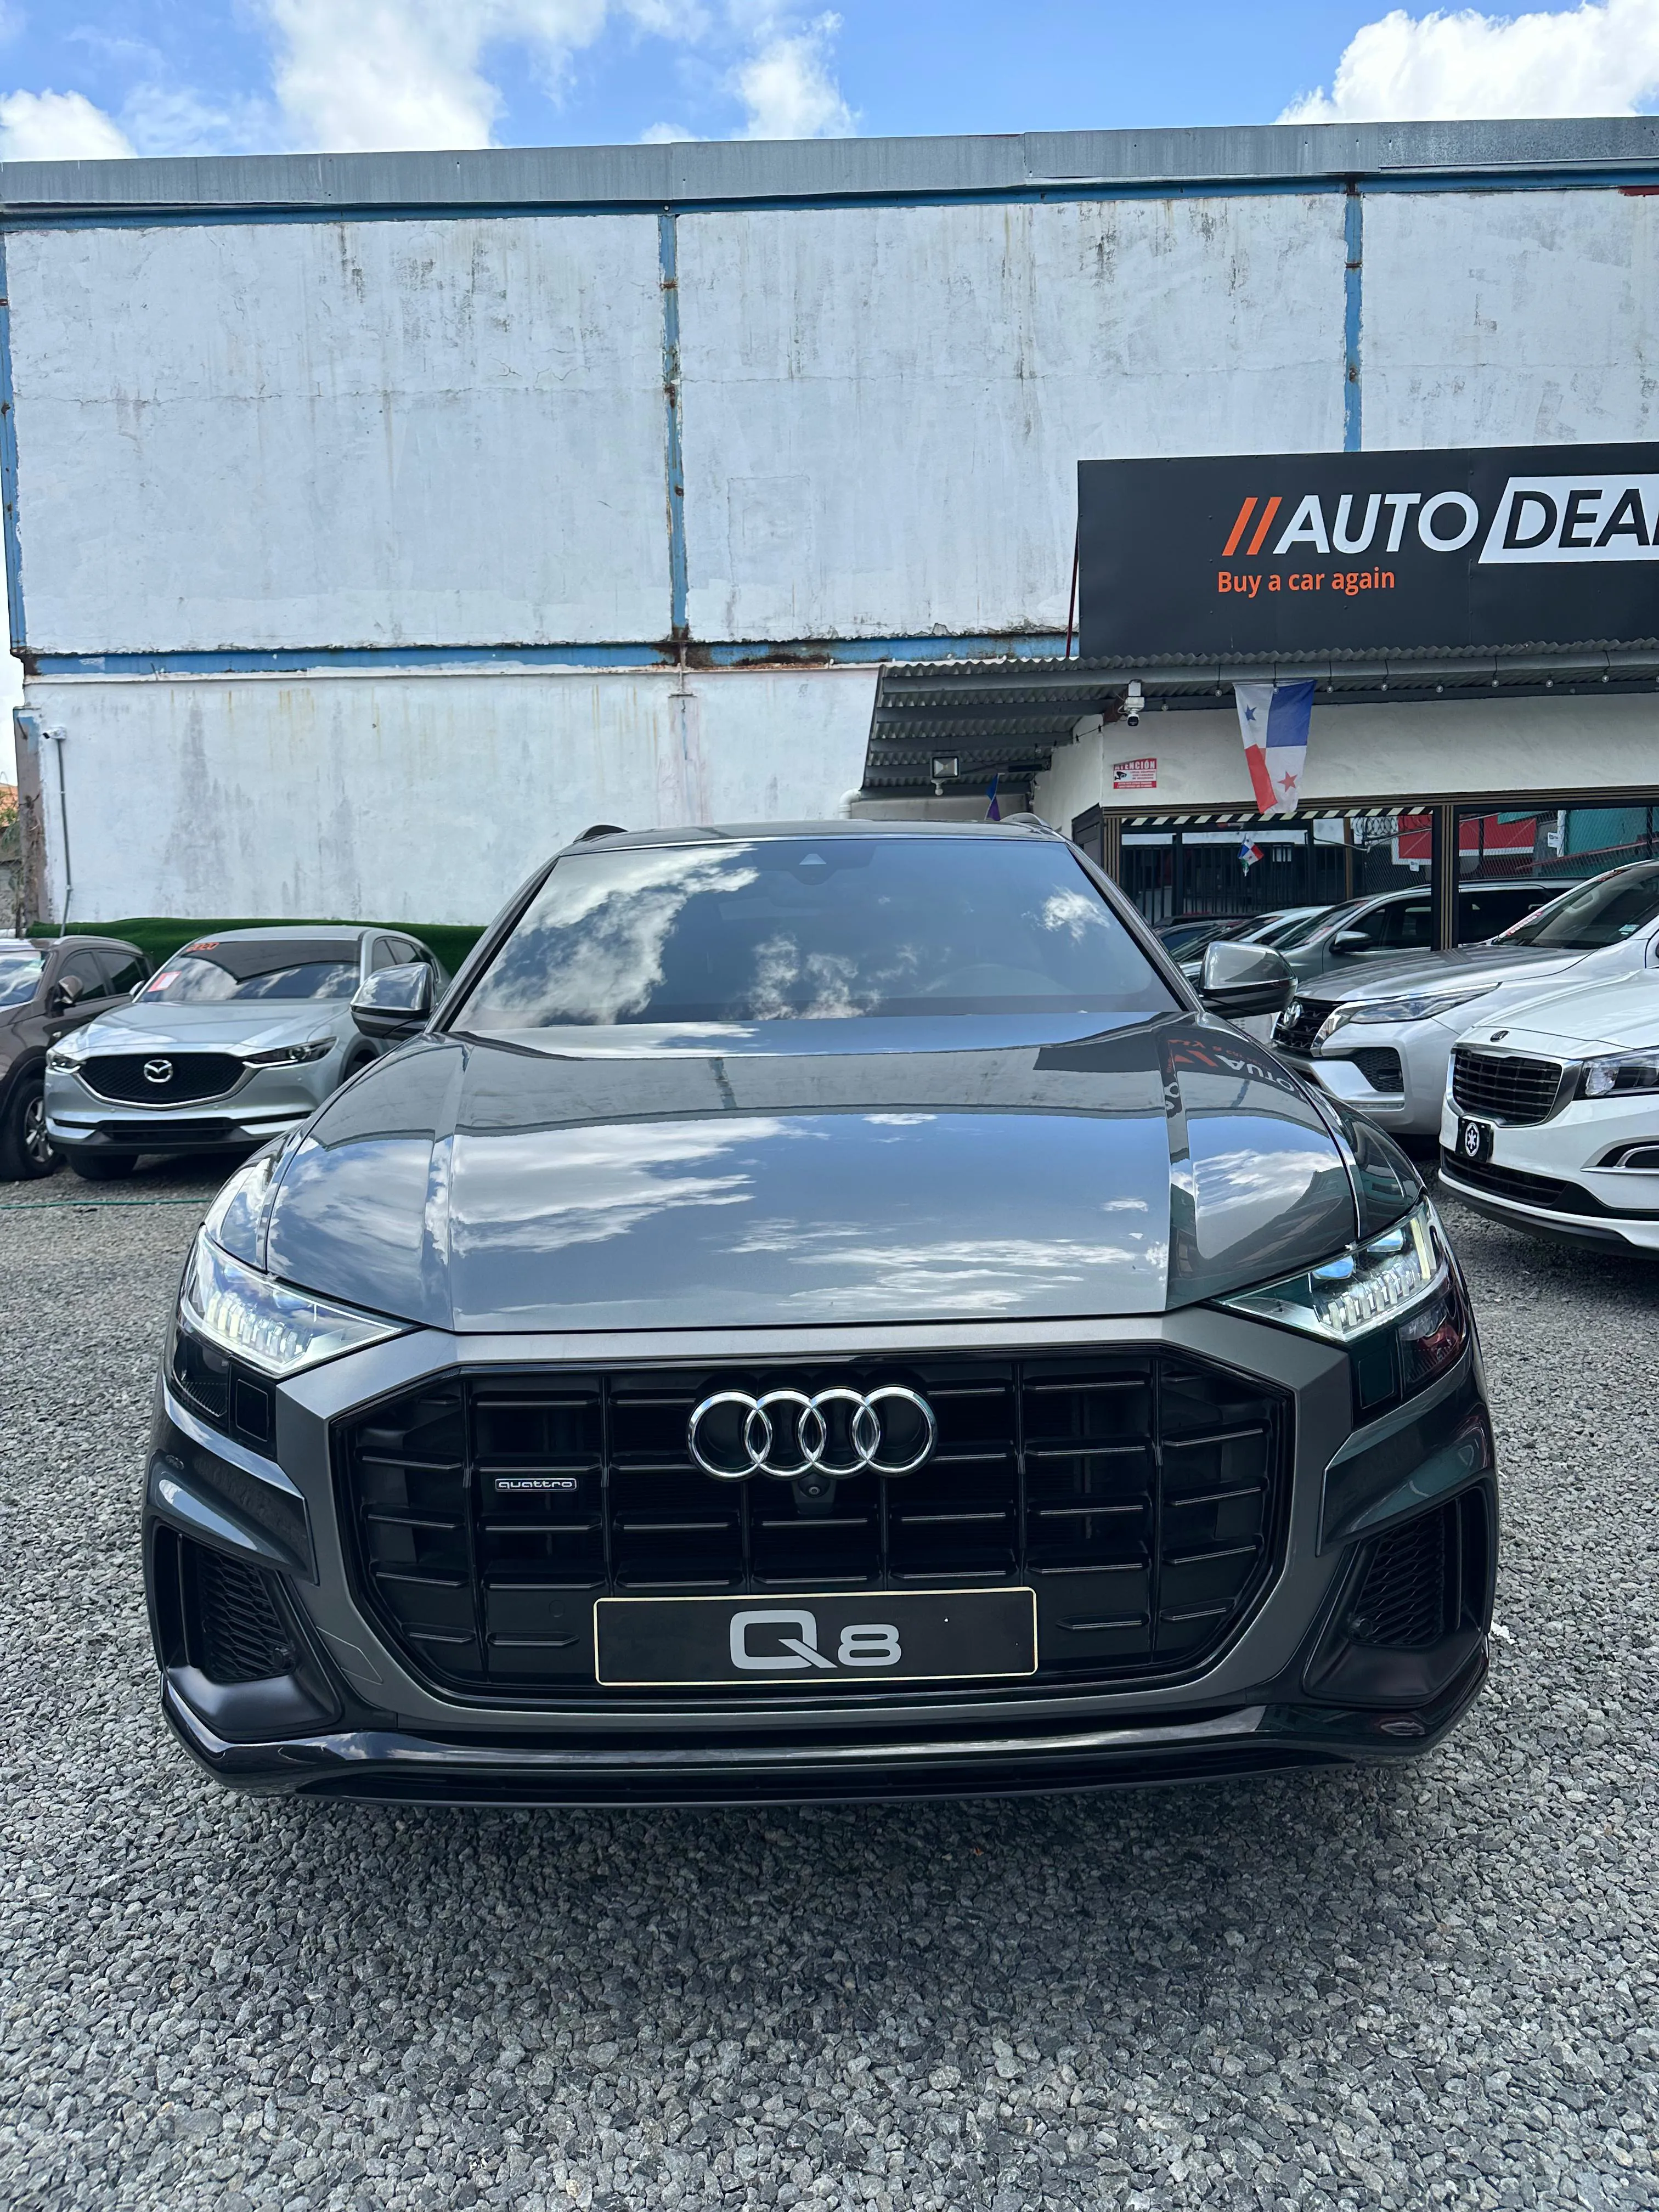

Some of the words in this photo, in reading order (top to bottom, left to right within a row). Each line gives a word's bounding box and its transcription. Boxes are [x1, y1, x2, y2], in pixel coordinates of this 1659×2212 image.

[1502, 488, 1659, 549] DEA
[1217, 572, 1262, 598] Buy
[1268, 573, 1281, 591] a
[1288, 572, 1325, 590] car
[1331, 566, 1395, 596] again
[498, 1480, 573, 1489] quattro
[730, 1609, 902, 1670] Q8
